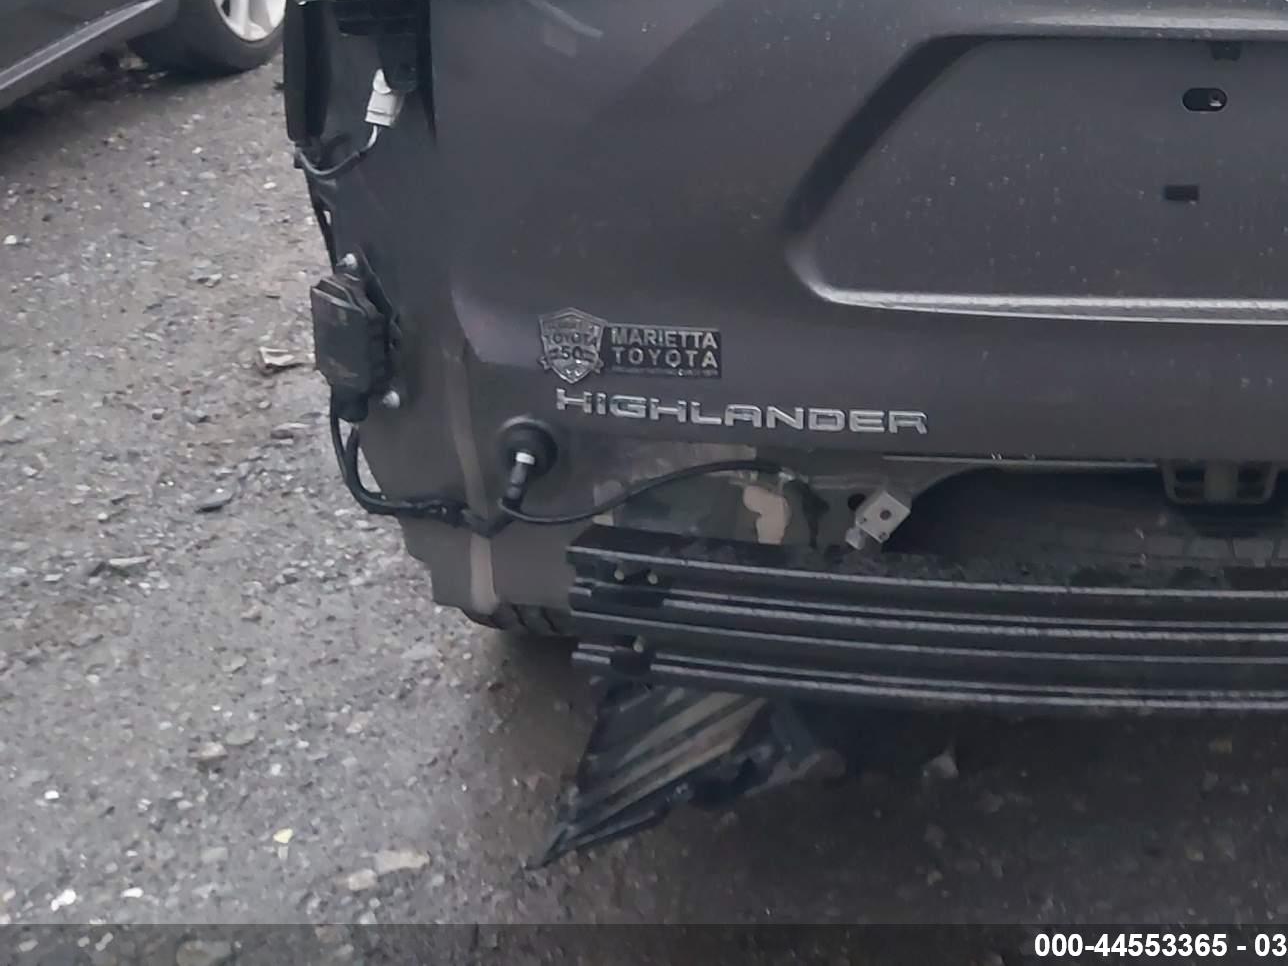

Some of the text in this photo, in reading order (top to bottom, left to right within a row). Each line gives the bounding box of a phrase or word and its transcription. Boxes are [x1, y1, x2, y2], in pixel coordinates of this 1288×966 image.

[610, 327, 718, 349] MARIETTA
[561, 345, 583, 360] 50
[611, 346, 718, 368] TOYOTA
[555, 388, 928, 434] HIGHLANDER
